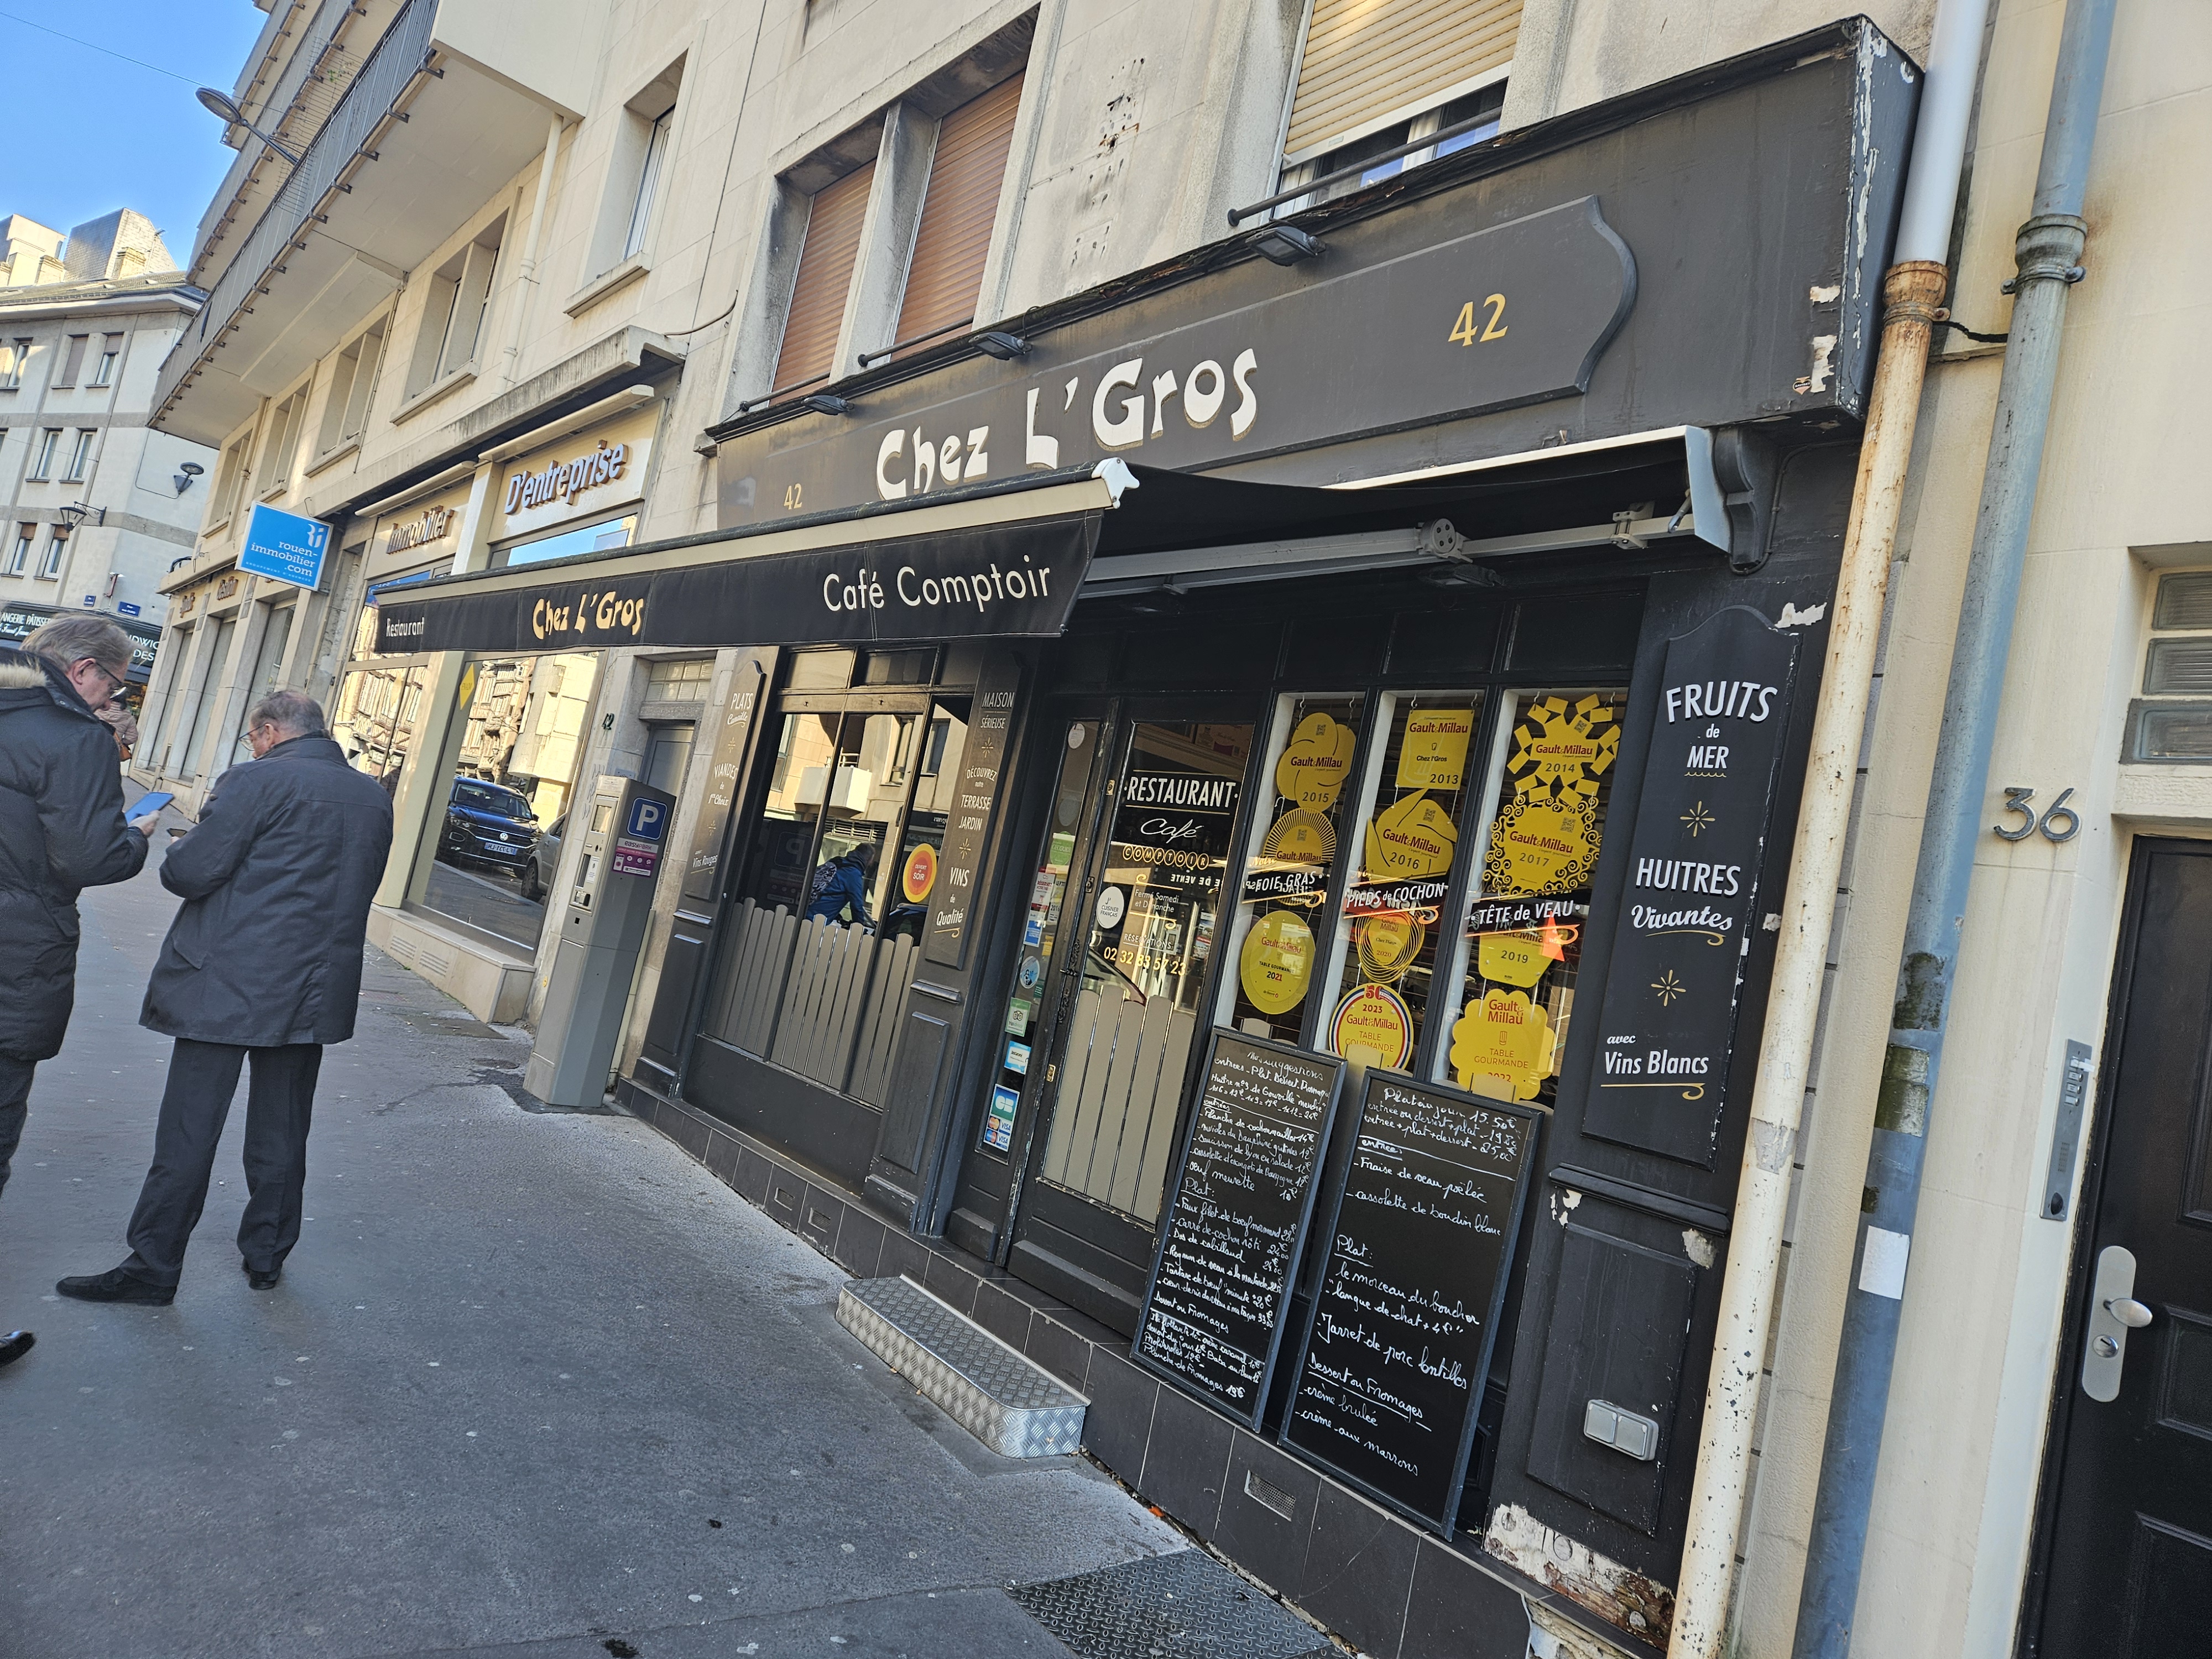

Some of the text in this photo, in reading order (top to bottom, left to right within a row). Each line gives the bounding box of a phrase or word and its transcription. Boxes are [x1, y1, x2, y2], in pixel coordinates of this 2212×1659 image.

[1448, 293, 1508, 346] 42
[877, 425, 988, 500] Chez
[504, 440, 629, 515] D'entreprise
[784, 483, 802, 510] 42
[386, 505, 454, 554] Immobilier
[251, 542, 315, 567] immobilier
[279, 541, 318, 557] rouen-
[284, 564, 312, 577] .com
[823, 555, 1050, 612] Café Comptoir
[386, 617, 424, 637] Restaurant
[533, 598, 570, 640] Chez
[731, 692, 754, 709] PLATS
[982, 691, 1015, 709] MAISON
[1666, 680, 1778, 725] FRUITS
[980, 716, 1006, 729] SÉRIEUSE
[1705, 723, 1720, 739] de
[1686, 745, 1729, 770] MER
[714, 763, 738, 780] VIANDES
[966, 765, 998, 782] DÉCOUVREZ
[1545, 763, 1575, 773] 2014
[719, 781, 724, 790] de
[1430, 774, 1459, 784] 2013
[1127, 775, 1237, 809] RESTAURANT
[1302, 792, 1329, 802] 2015
[961, 794, 992, 812] TERRASSE
[637, 804, 659, 831] P
[958, 816, 983, 831] JARDIN
[1994, 787, 2083, 843] 36
[1140, 817, 1204, 844] Café
[692, 853, 718, 869] Vins Rouges
[1123, 846, 1208, 869] COMPTOIR
[1390, 852, 1420, 870] 2016
[1519, 852, 1550, 867] 2017
[912, 872, 925, 881] SOIR
[949, 866, 969, 887] VINS
[1255, 875, 1281, 892] FOIE
[1286, 870, 1316, 886] GRAS
[1635, 857, 1741, 897] HUITRES
[950, 893, 956, 904] de
[1135, 889, 1179, 904] Fermé Samedi
[1346, 883, 1445, 908] PIEDS de COCHON
[936, 908, 964, 927] Qualité
[1479, 900, 1574, 924] TÊTE de VEAU
[1631, 904, 1733, 930] Vivantes
[1380, 922, 1399, 932] Millau
[1104, 947, 1118, 961] 02
[1120, 950, 1134, 965] 32
[1153, 957, 1170, 971] 57
[1171, 961, 1187, 976] 23
[1259, 961, 1270, 969] TABLE
[1501, 950, 1528, 963] 2019
[1266, 971, 1282, 982] 2021
[1363, 1004, 1383, 1014] 2023
[1488, 1010, 1523, 1025] Millau
[1359, 1031, 1381, 1041] TABLE
[1606, 1034, 1636, 1045] avec
[1474, 1056, 1528, 1068] GOURMANDE
[1489, 1048, 1514, 1058] TABLE
[1604, 1048, 1709, 1076] Vins Blancs
[1384, 1087, 1417, 1105] Plat
[1368, 1100, 1413, 1120] entrée ou
[1001, 1122, 1011, 1131] VISA
[1235, 1118, 1245, 1128] de
[999, 1135, 1008, 1144] VISA
[1396, 1167, 1412, 1180] de
[1413, 1173, 1442, 1188] veau
[1355, 1187, 1501, 1236] cassolette de boudin blanc
[1187, 1233, 1198, 1245] de
[1332, 1281, 1423, 1328] langue de chat
[1352, 1272, 1406, 1300] morceau
[1408, 1289, 1428, 1308] du
[1430, 1290, 1480, 1325] boucher
[1364, 1332, 1381, 1351] de
[1383, 1346, 1413, 1368] porc
[1308, 1352, 1423, 1423] Dessert ou Fromages
[1364, 1441, 1418, 1477] marrons
